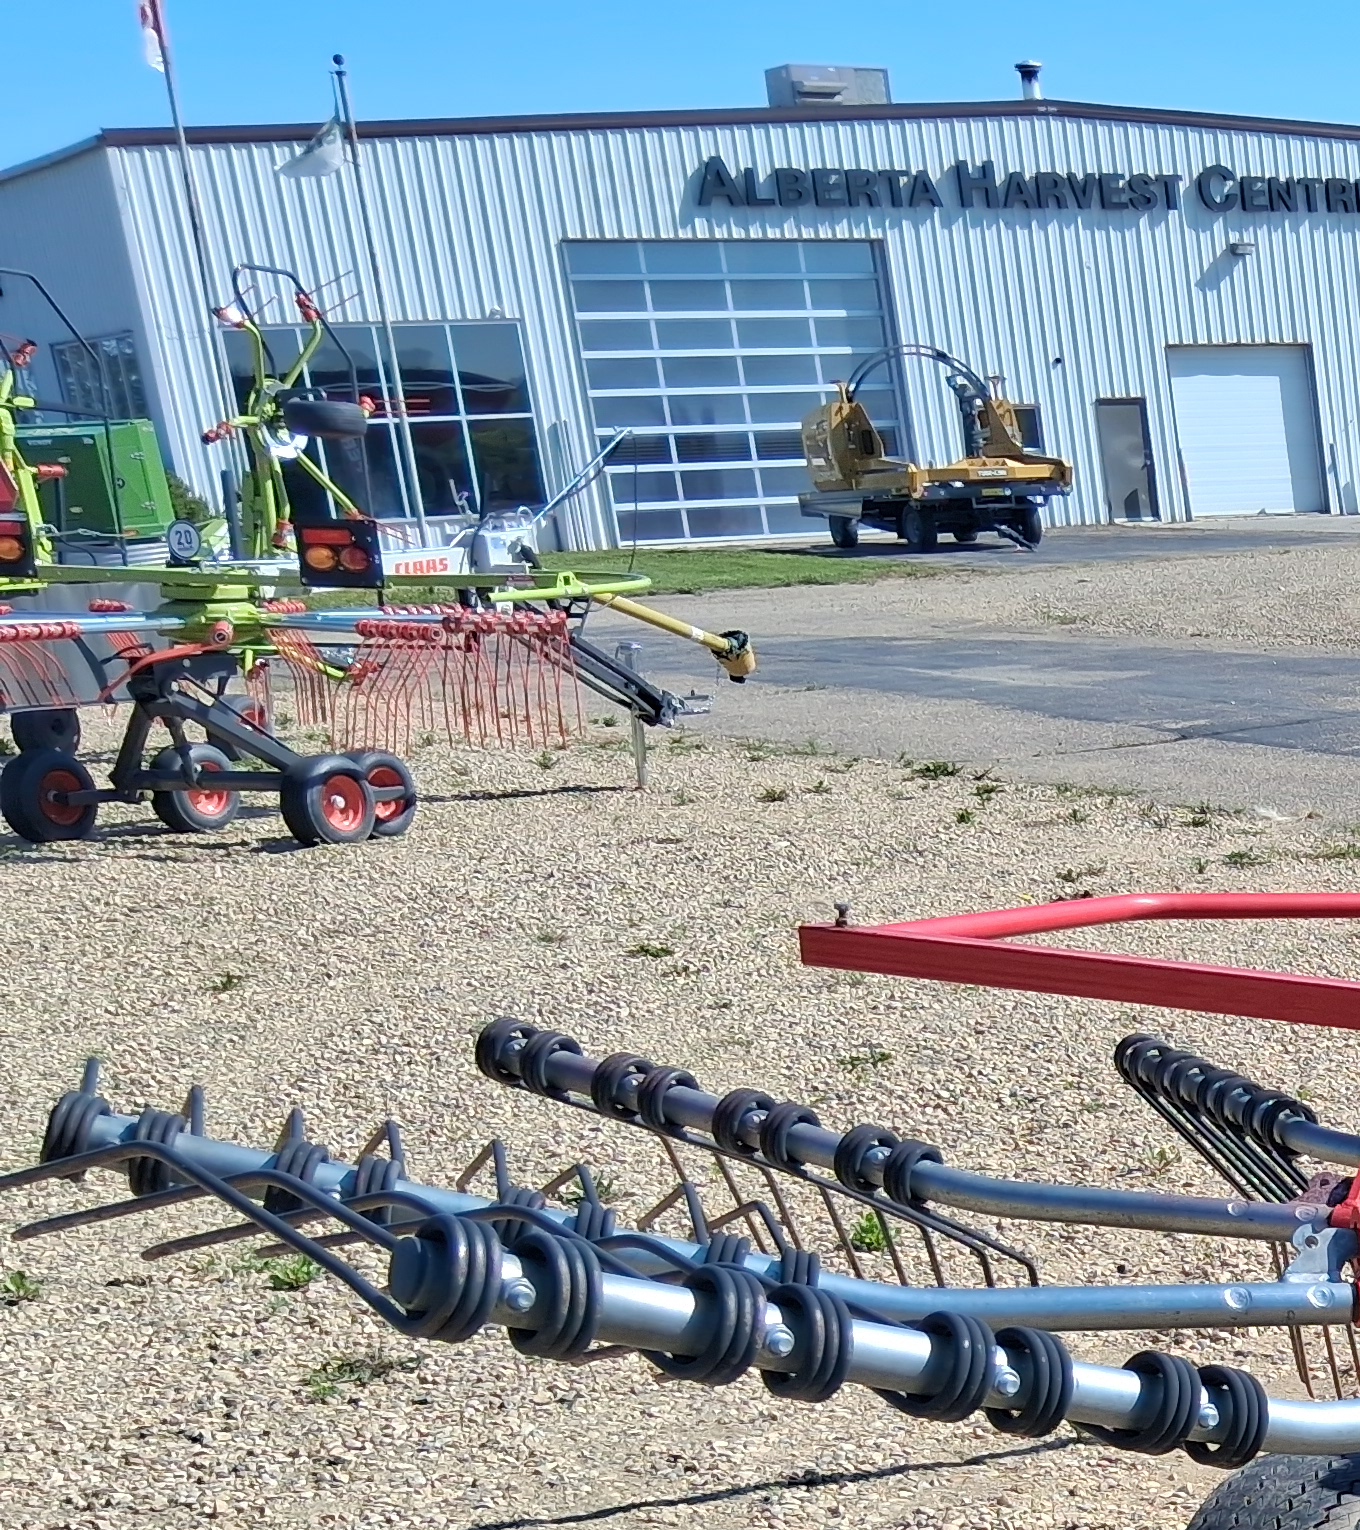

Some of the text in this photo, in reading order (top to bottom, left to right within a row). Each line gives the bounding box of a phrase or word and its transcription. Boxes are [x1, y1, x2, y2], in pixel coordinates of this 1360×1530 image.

[698, 155, 944, 208] ALBERTA
[956, 159, 1183, 211] HARVEST
[175, 530, 194, 546] 20
[394, 557, 449, 575] CLAAS
